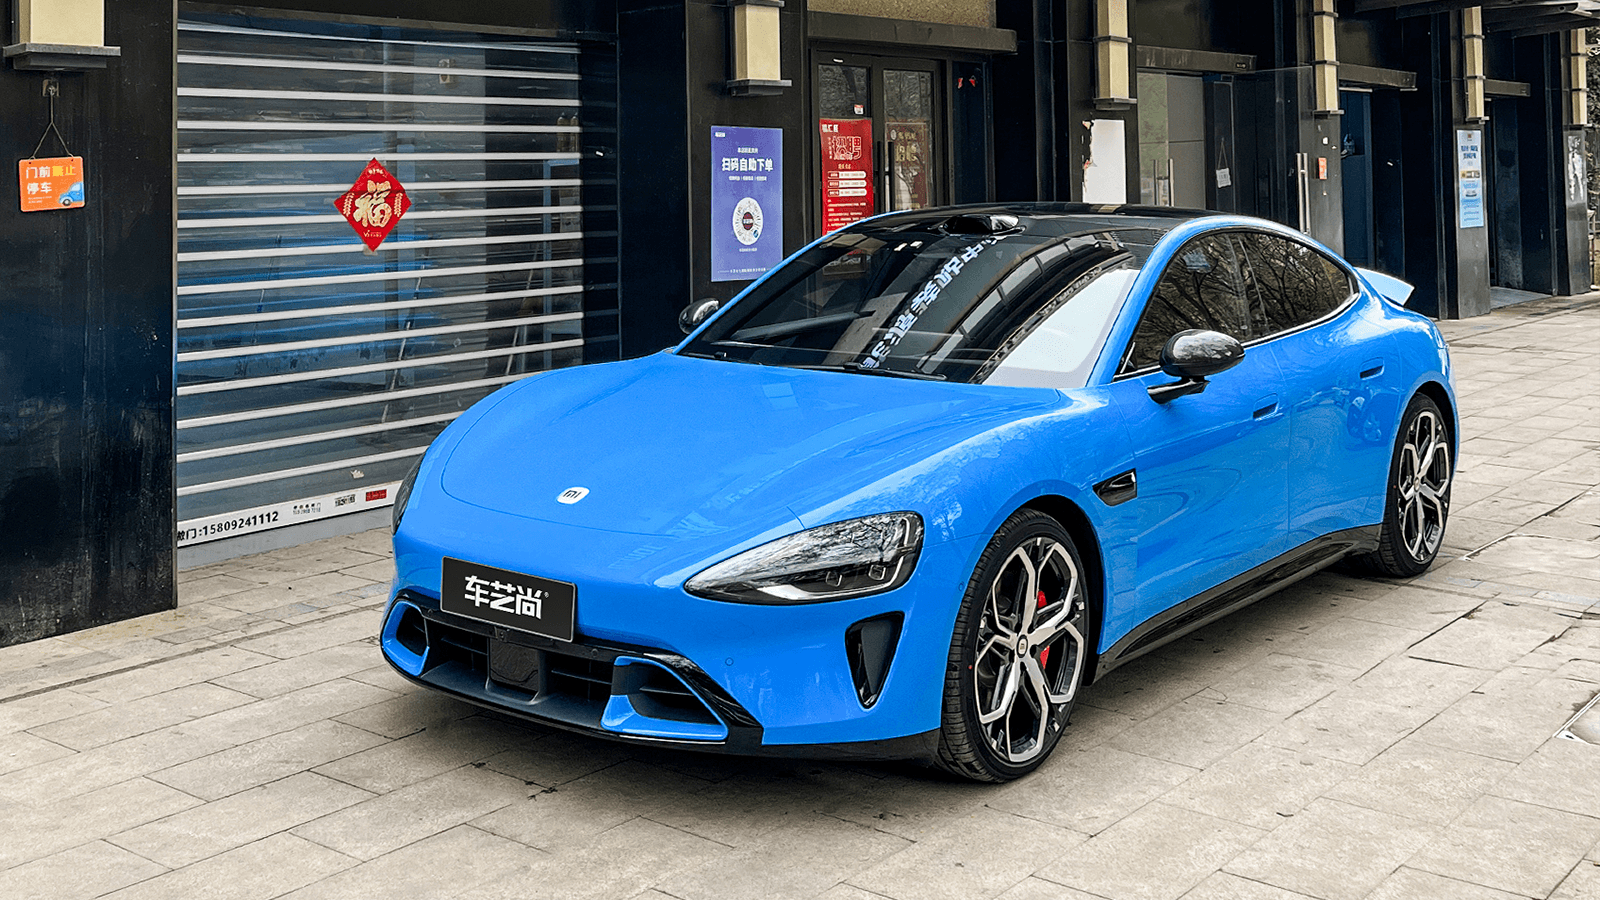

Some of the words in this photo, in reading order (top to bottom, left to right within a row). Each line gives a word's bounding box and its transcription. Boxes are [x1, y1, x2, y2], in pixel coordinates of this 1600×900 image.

[722, 157, 773, 171] 扫码自助下单
[353, 179, 392, 228] 福
[464, 575, 541, 620] 车艺尚
